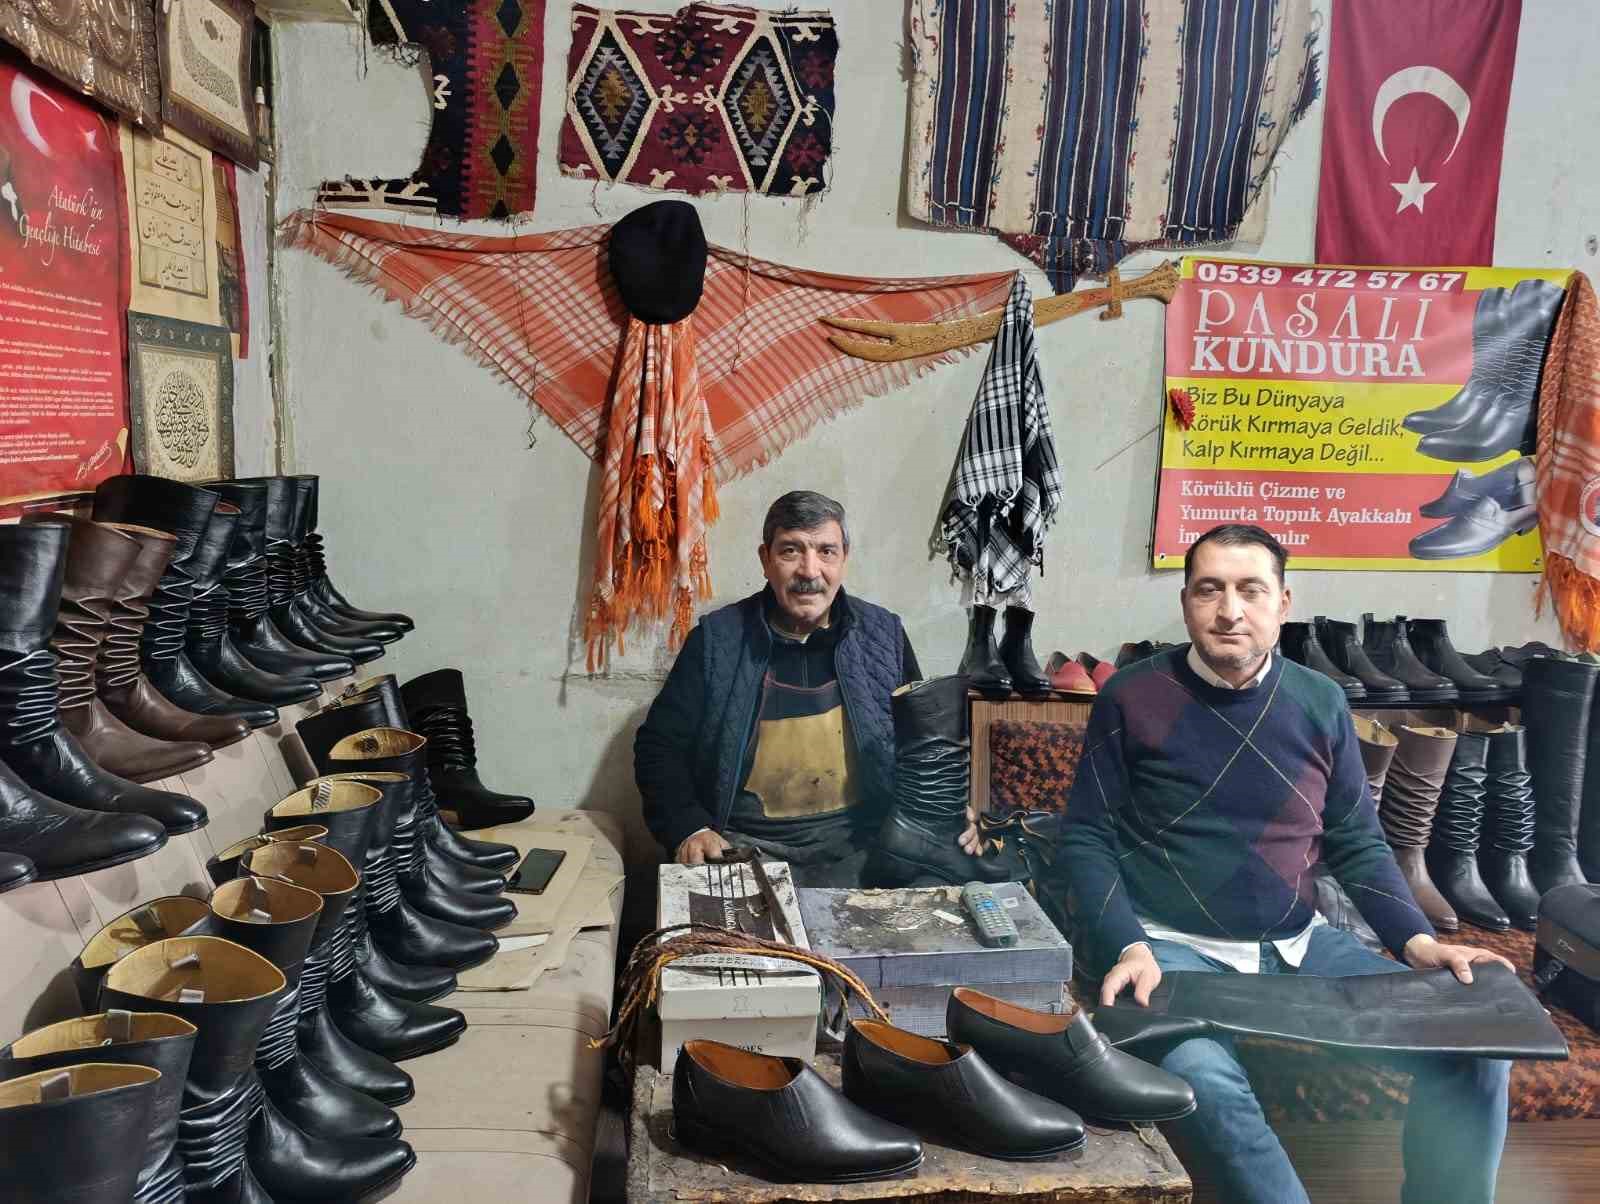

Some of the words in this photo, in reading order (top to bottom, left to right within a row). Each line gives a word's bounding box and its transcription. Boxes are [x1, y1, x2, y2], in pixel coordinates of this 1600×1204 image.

[1198, 263, 1282, 286] 0539
[1291, 269, 1356, 289] 472
[1366, 272, 1410, 290] 57
[1418, 273, 1463, 292] 67
[1190, 335, 1426, 378] KUNDURA
[1186, 386, 1217, 406] Biz
[1223, 387, 1251, 406] Bu
[1256, 388, 1345, 415] Dünyaya
[1189, 414, 1242, 432] örük
[1247, 415, 1332, 439] Kırmaya
[1182, 439, 1225, 465] Kalp
[1230, 441, 1314, 467] Kırmaya
[1320, 443, 1385, 466] Değil...
[1180, 480, 1254, 498] Körüklü
[1259, 481, 1320, 501] Çizme
[1325, 487, 1346, 500] ve
[1180, 504, 1258, 521] Yumurta
[1263, 506, 1322, 524] Topuk
[1326, 508, 1412, 527] Ayakkabı
